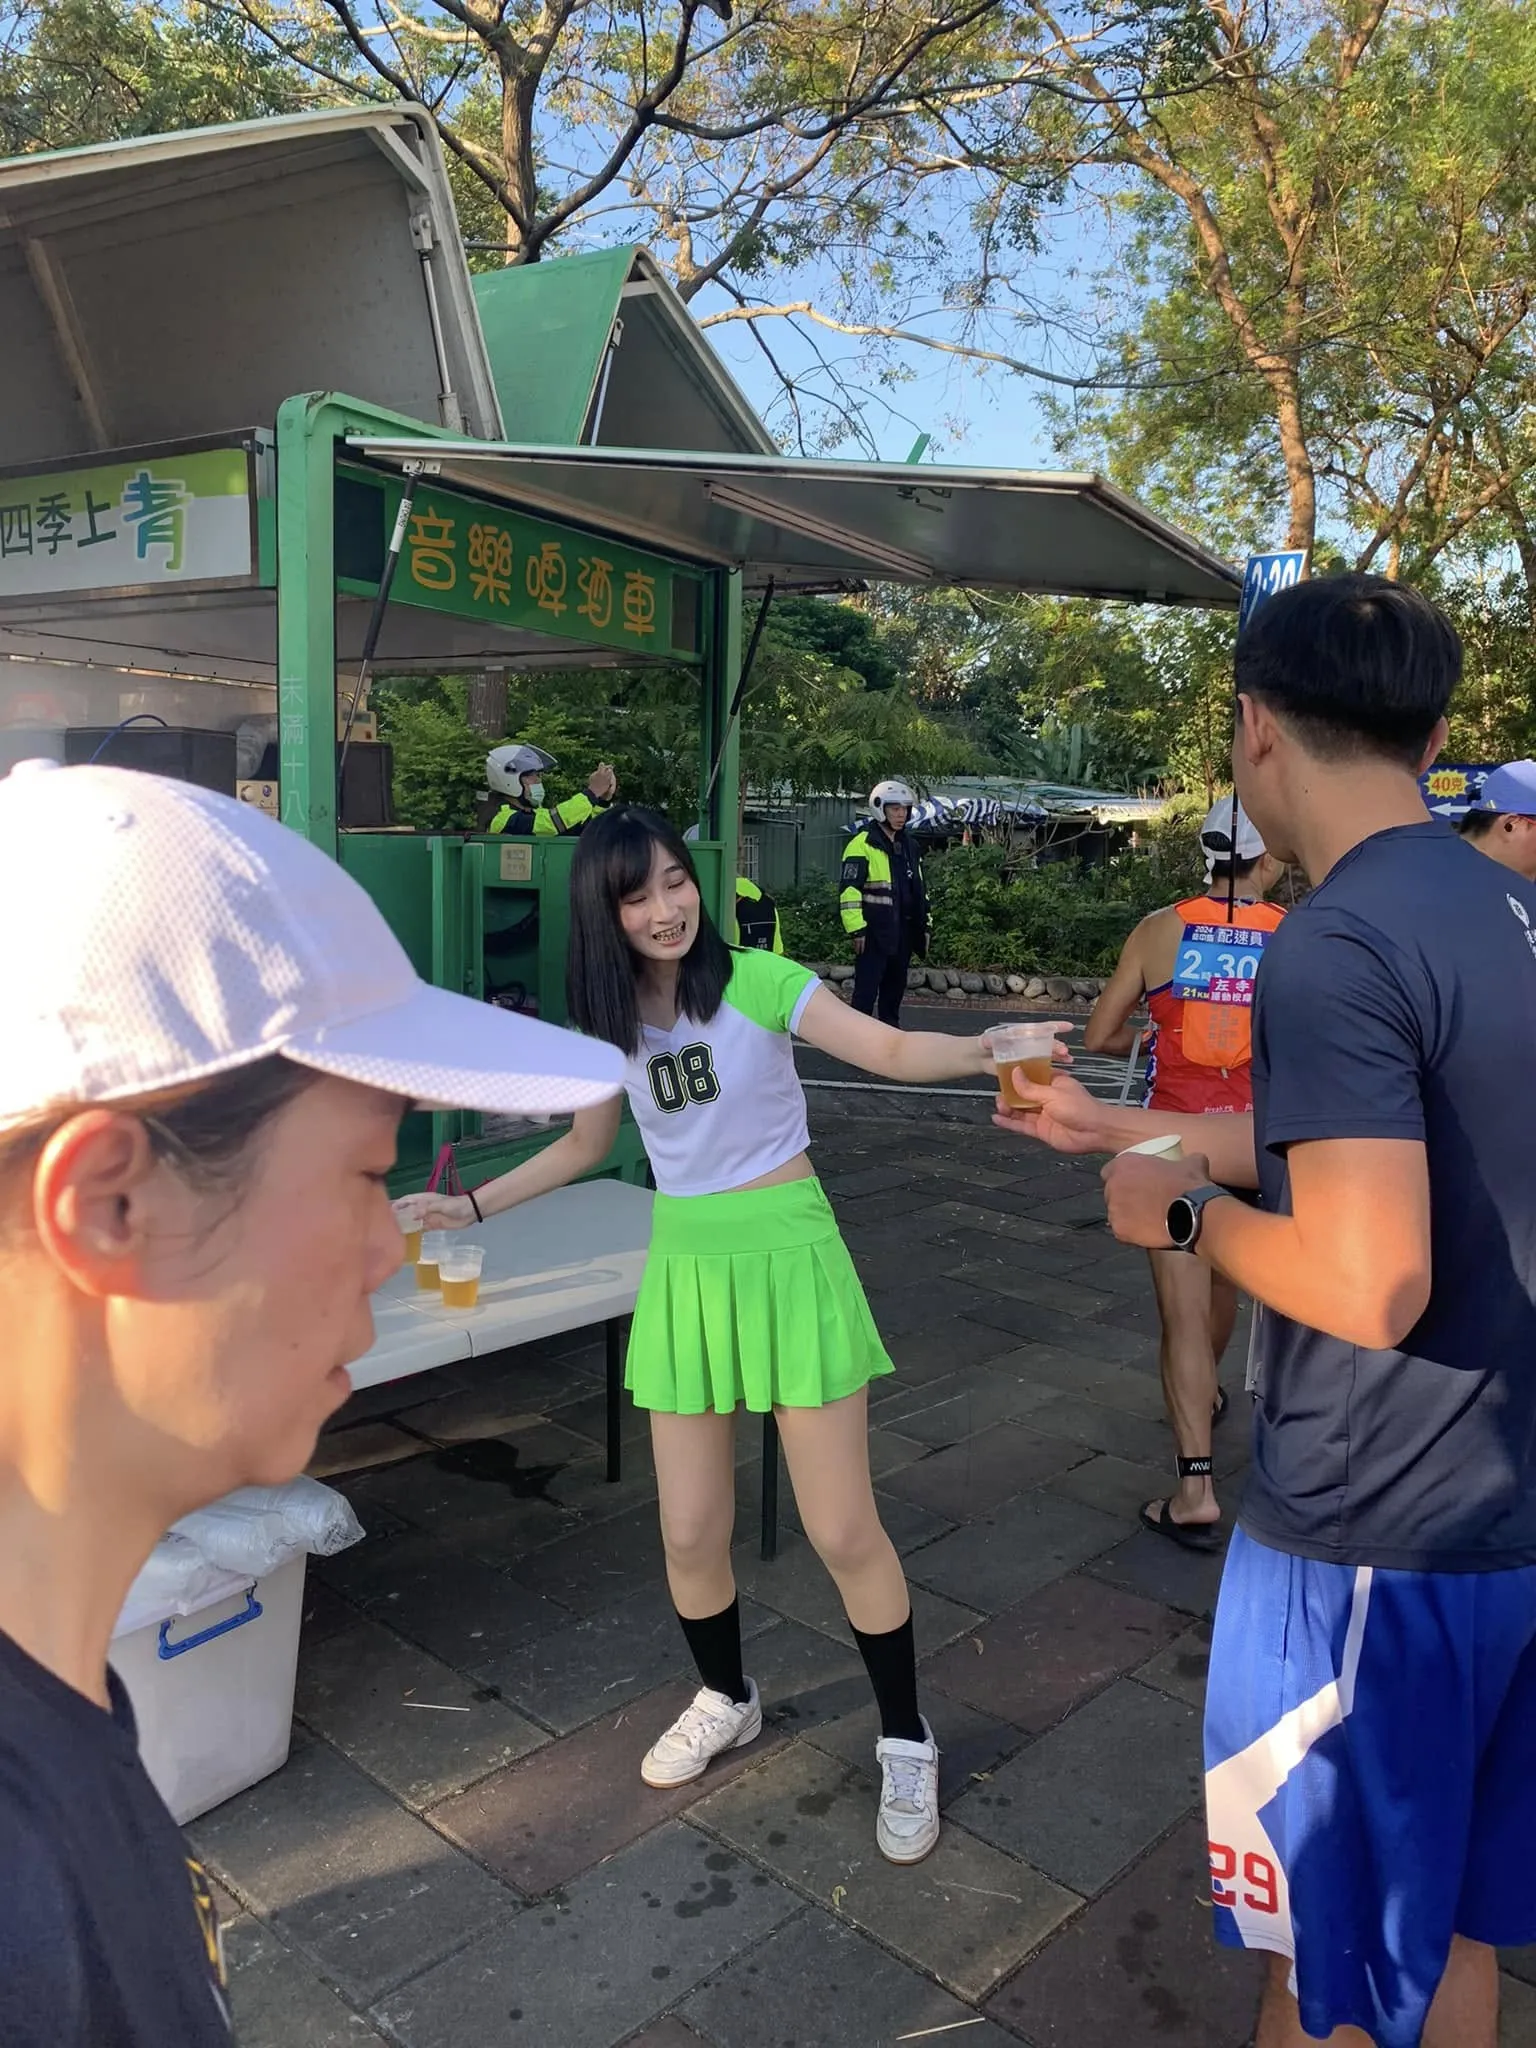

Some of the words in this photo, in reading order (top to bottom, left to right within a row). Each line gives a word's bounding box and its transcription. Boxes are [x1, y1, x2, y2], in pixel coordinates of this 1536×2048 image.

[0, 470, 190, 572] 四季上青
[408, 506, 656, 637] 音樂啤酒車
[1217, 927, 1263, 946] 配速員
[646, 1041, 721, 1113] 08
